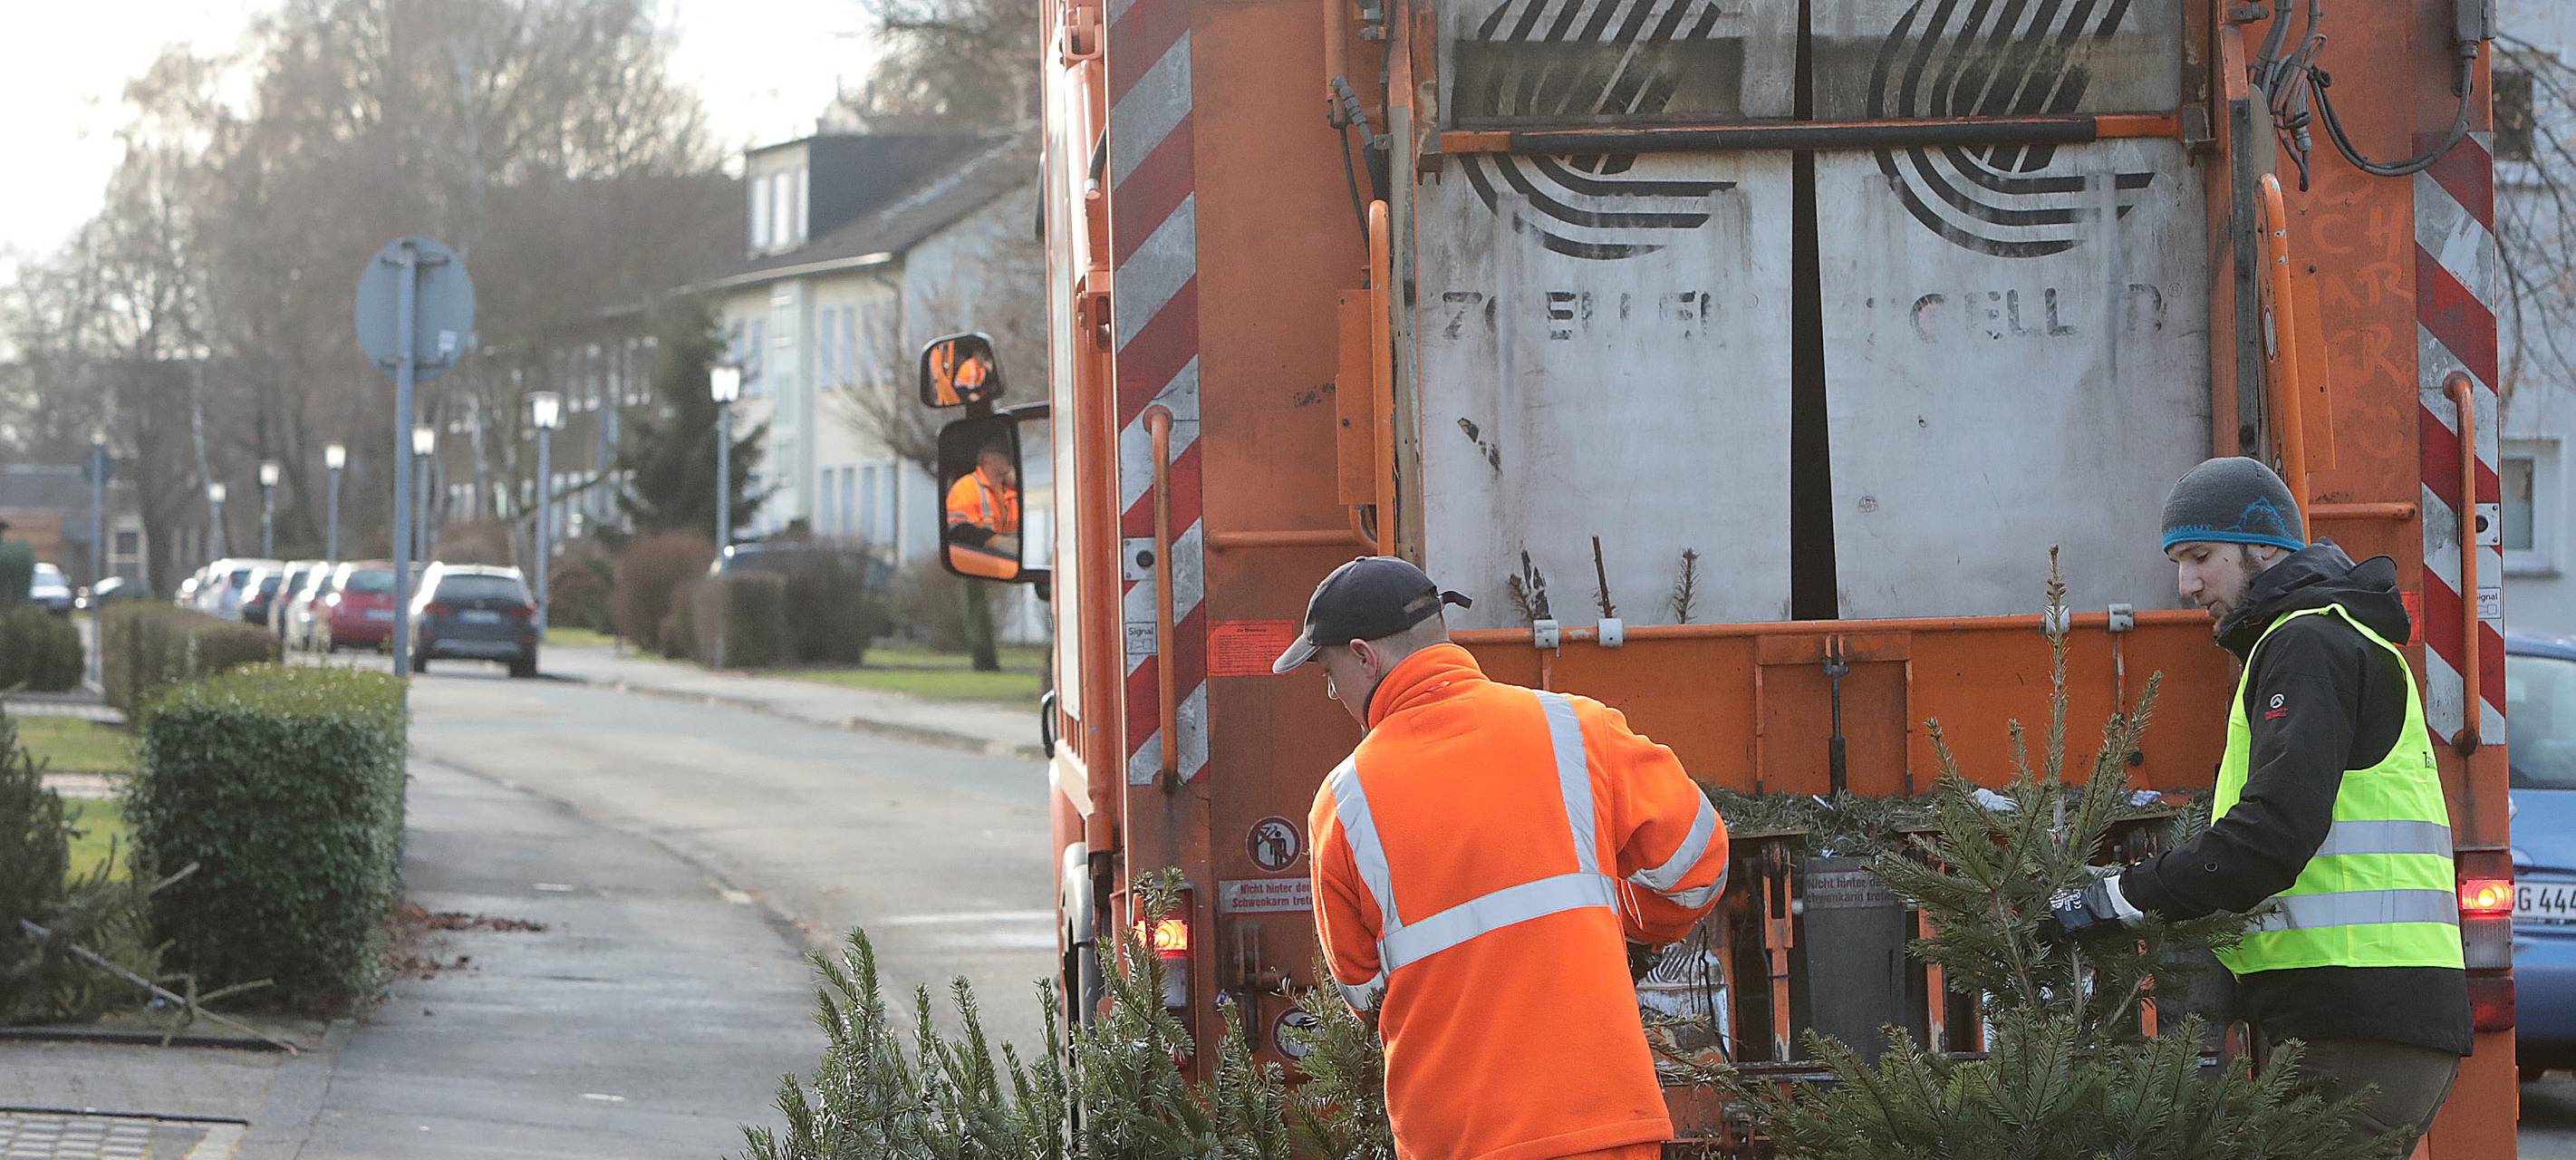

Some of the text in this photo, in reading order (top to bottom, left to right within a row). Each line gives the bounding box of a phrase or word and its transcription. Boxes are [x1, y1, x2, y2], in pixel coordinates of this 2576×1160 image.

[2476, 593, 2498, 602] ignal
[1128, 626, 1153, 636] Signal
[1869, 876, 1883, 887] de
[1240, 884, 1263, 894] Nicht
[1266, 884, 1292, 893] hinter
[1232, 895, 1313, 907] Schwenkarm tret
